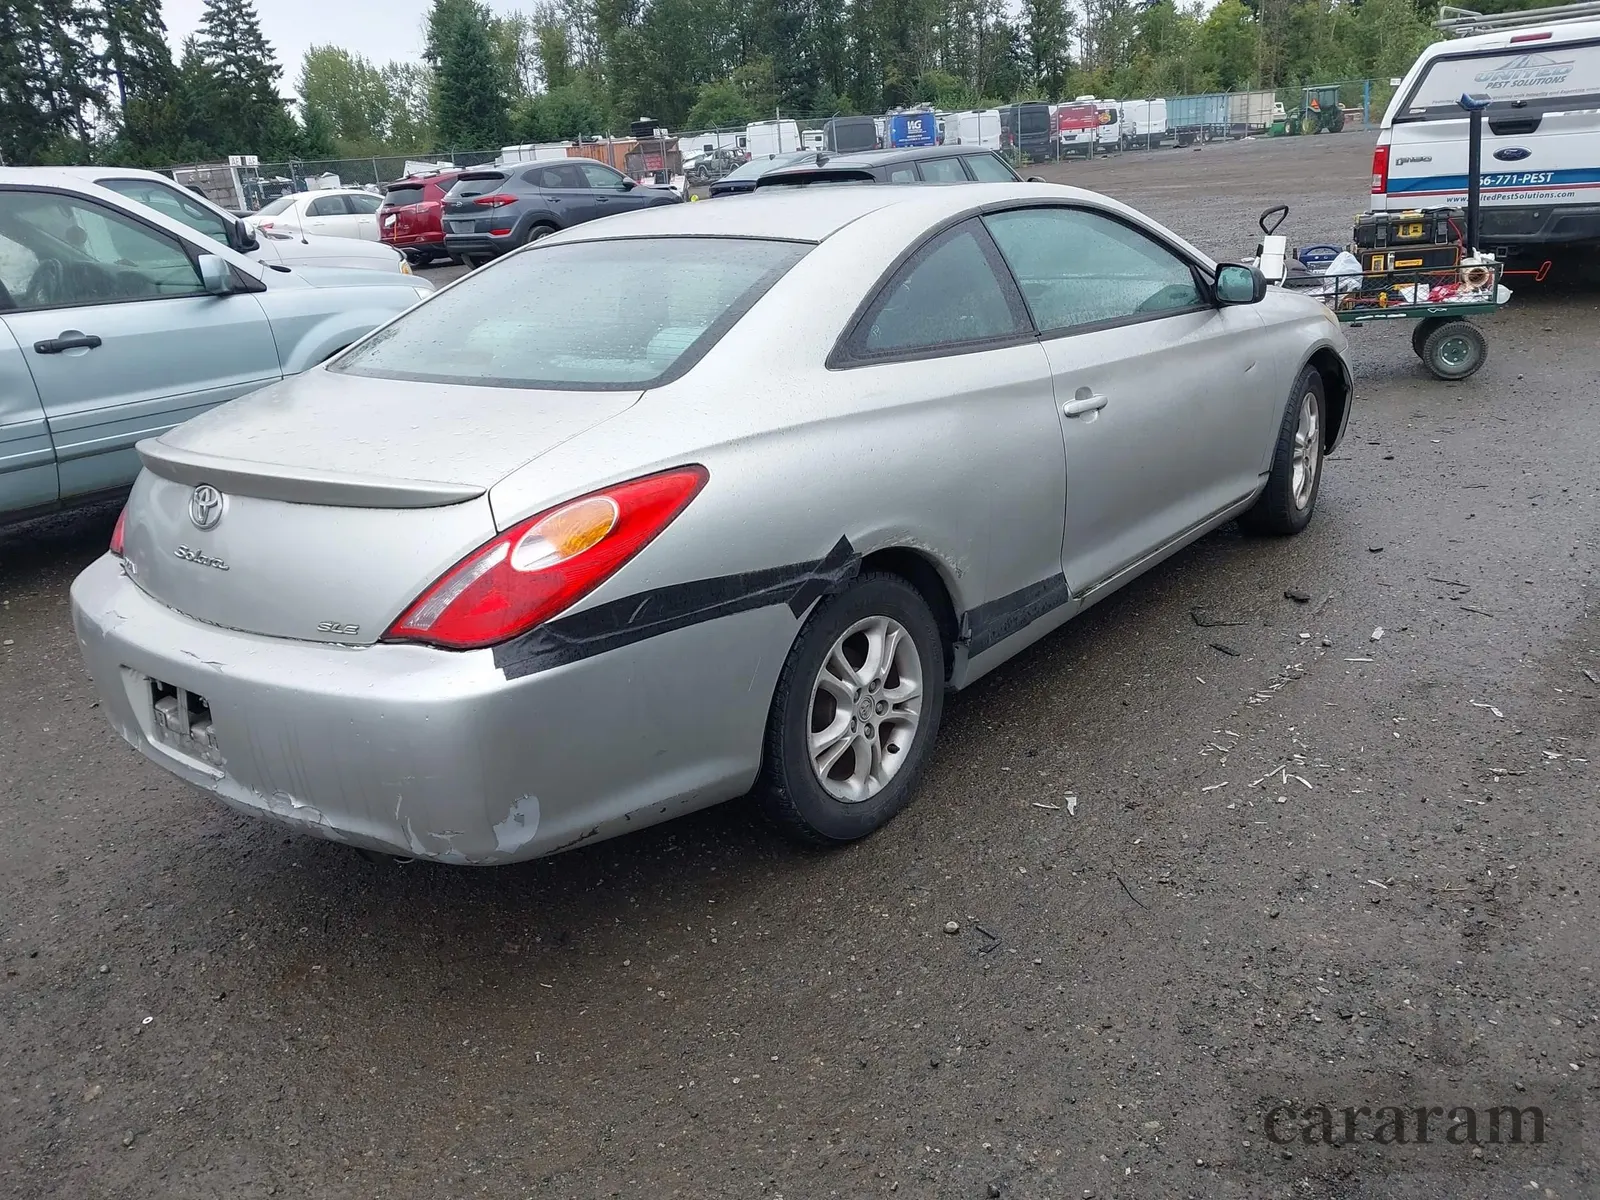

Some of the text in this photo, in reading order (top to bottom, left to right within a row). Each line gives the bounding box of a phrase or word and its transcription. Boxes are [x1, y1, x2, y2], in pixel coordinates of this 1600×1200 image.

[1485, 75, 1567, 90] PEST SOLUTIONS
[1446, 190, 1576, 203] www.itedPestSolutions.com
[173, 544, 230, 571] Solara
[317, 621, 359, 635] SLE
